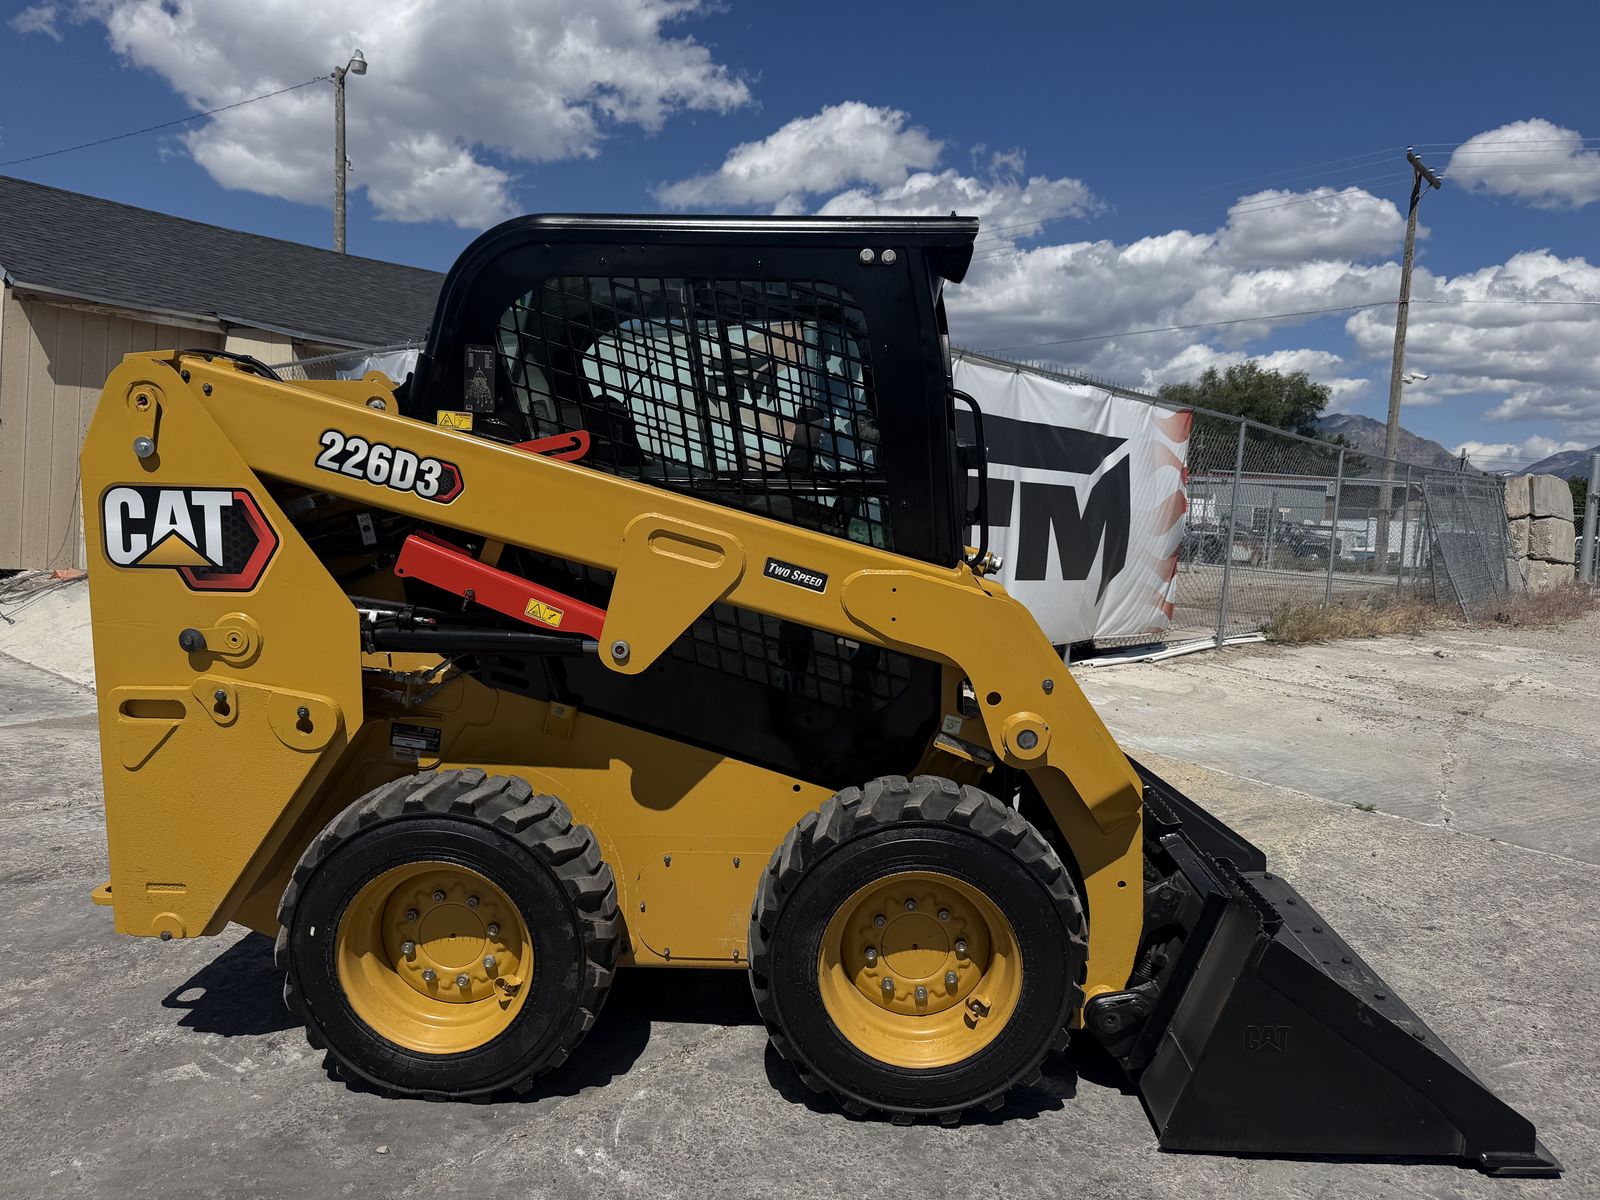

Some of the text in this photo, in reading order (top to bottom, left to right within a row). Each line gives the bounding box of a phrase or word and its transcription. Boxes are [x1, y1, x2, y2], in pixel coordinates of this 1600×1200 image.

[316, 430, 443, 497] 226D3
[104, 487, 233, 567] CAT
[1243, 1025, 1292, 1055] CAT
